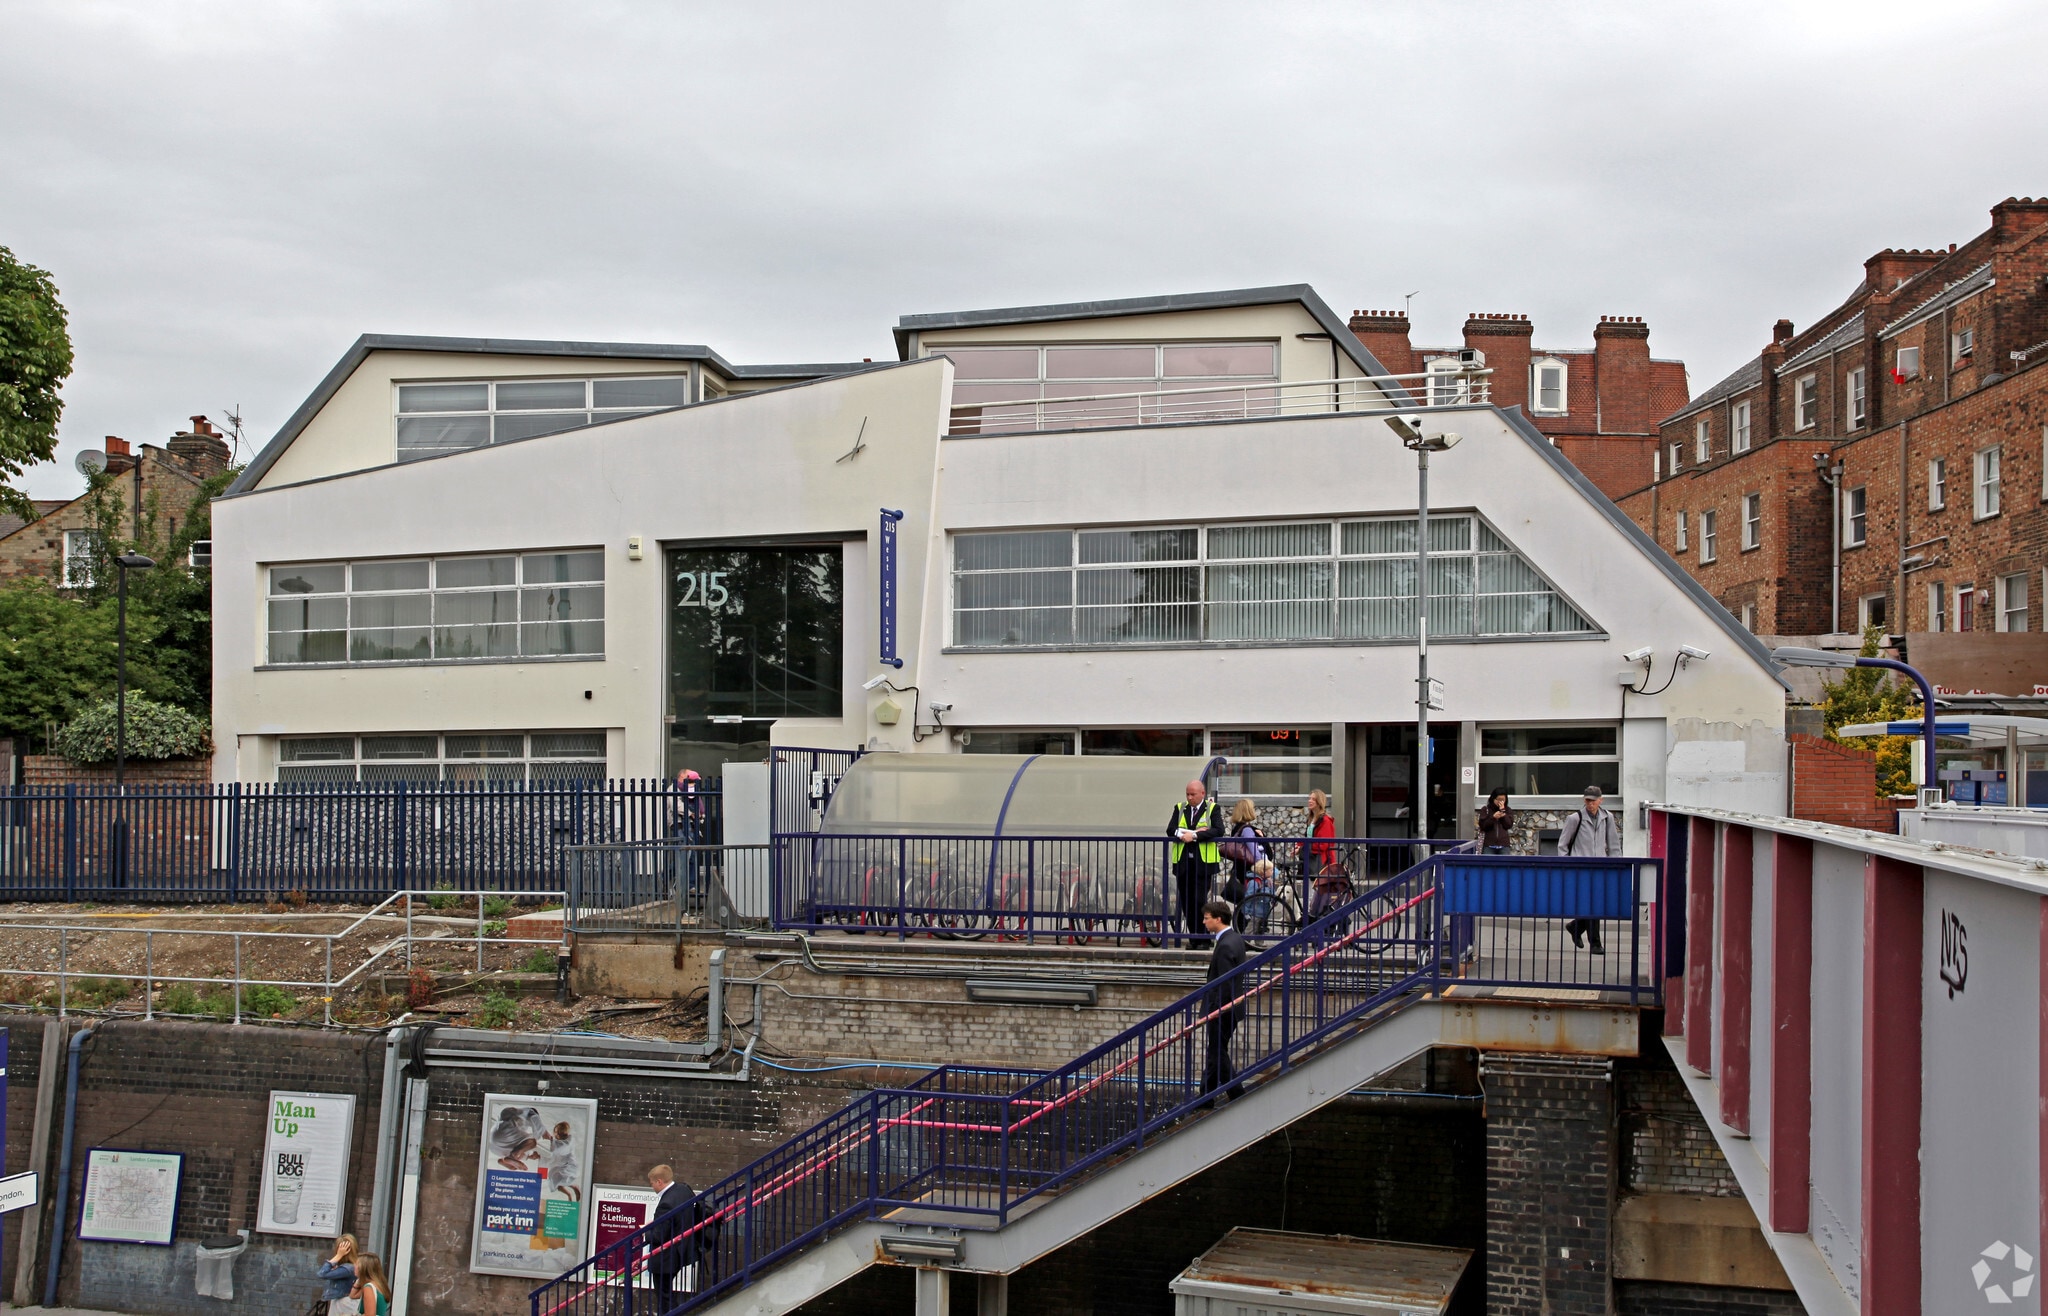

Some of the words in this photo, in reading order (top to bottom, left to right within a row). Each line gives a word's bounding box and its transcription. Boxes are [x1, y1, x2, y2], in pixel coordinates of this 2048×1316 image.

[885, 521, 895, 533] 215
[677, 572, 728, 607] 215
[815, 782, 820, 795] 2
[274, 1101, 316, 1118] Man
[274, 1118, 299, 1138] Up
[278, 1153, 304, 1165] BULL
[277, 1163, 304, 1176] DOG
[603, 1191, 621, 1199] Local
[623, 1192, 659, 1201] information
[602, 1204, 621, 1213] Sales
[487, 1213, 514, 1228] park
[515, 1213, 534, 1227] inn
[601, 1213, 607, 1221] &
[607, 1213, 636, 1224] Lettings
[483, 1250, 524, 1260] parkinn.co.uk
